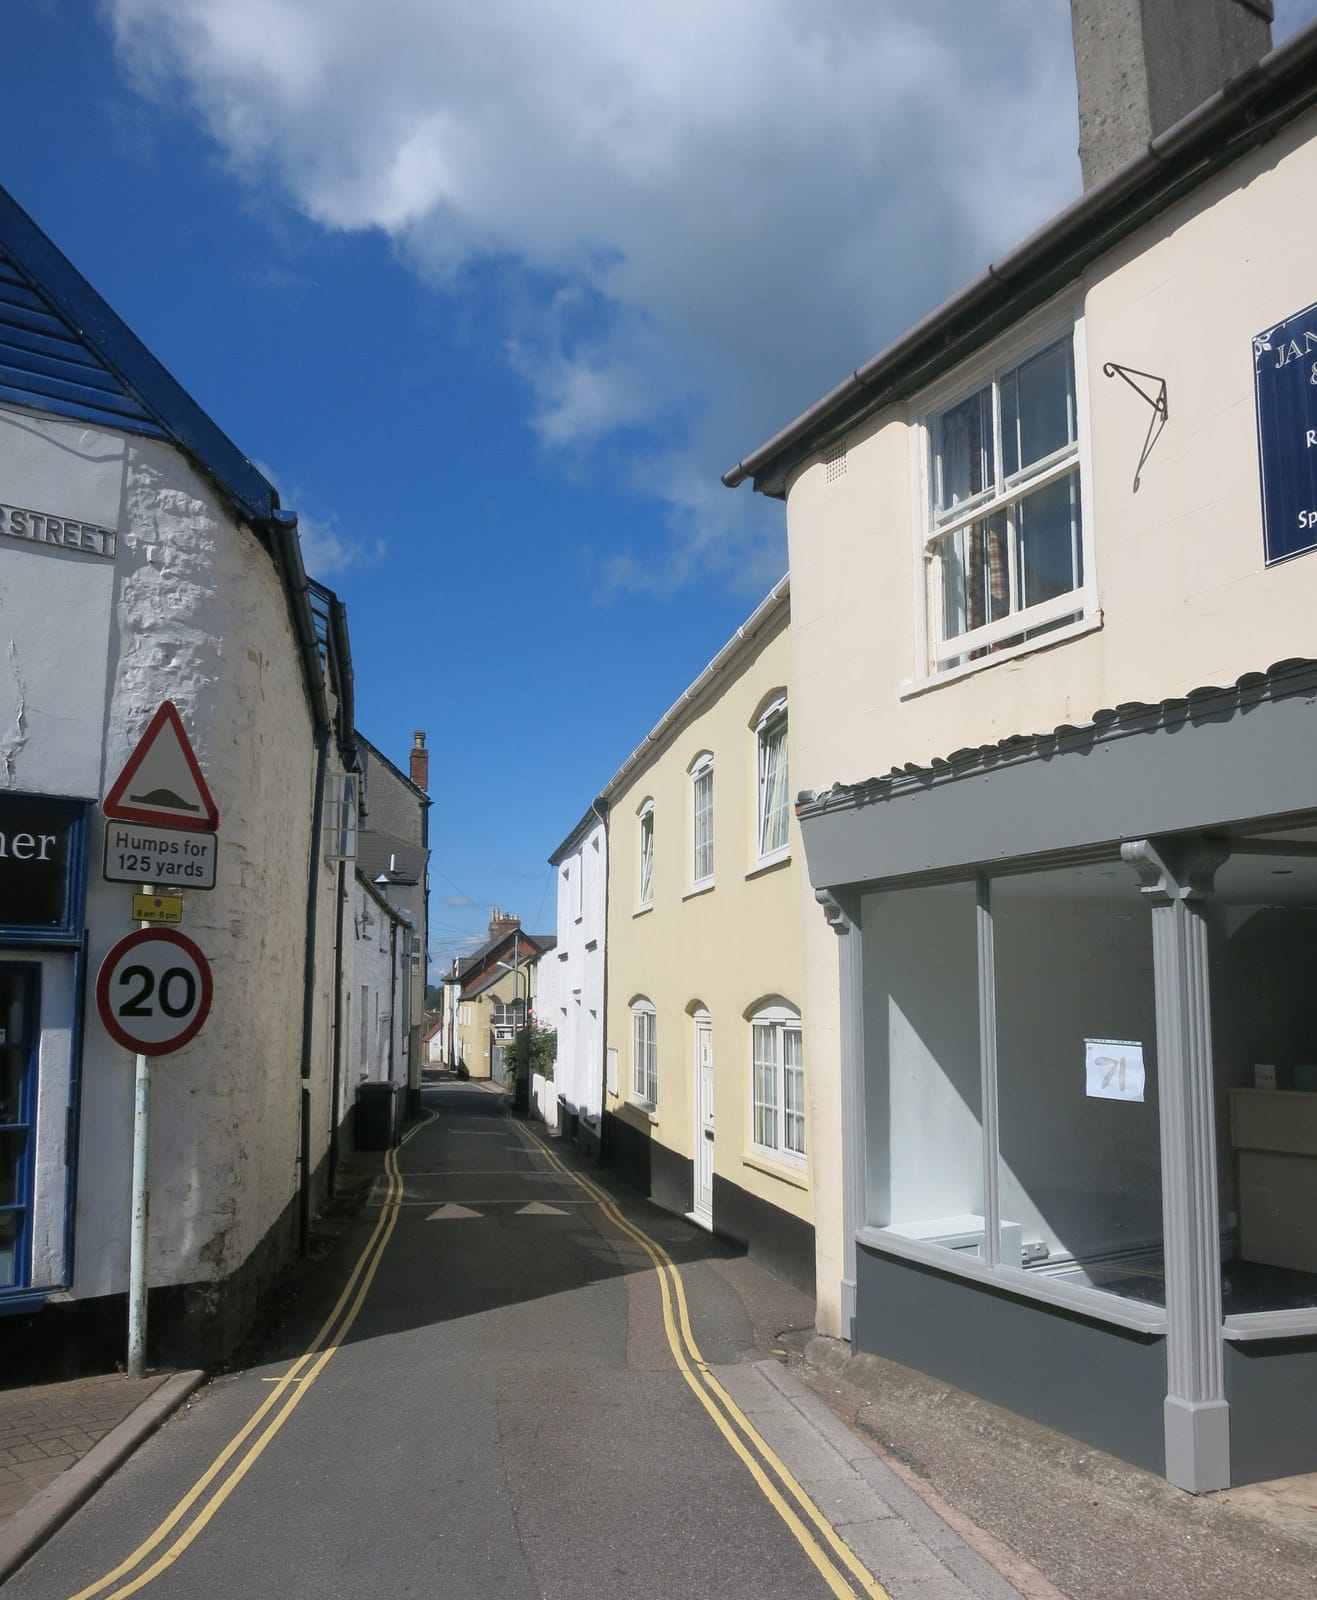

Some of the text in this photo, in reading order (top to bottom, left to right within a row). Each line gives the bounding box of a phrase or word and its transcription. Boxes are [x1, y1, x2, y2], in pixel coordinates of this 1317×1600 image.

[9, 510, 115, 556] STREET
[116, 831, 207, 857] Humps for
[119, 854, 204, 877] 125 yards
[119, 964, 196, 1019] 20
